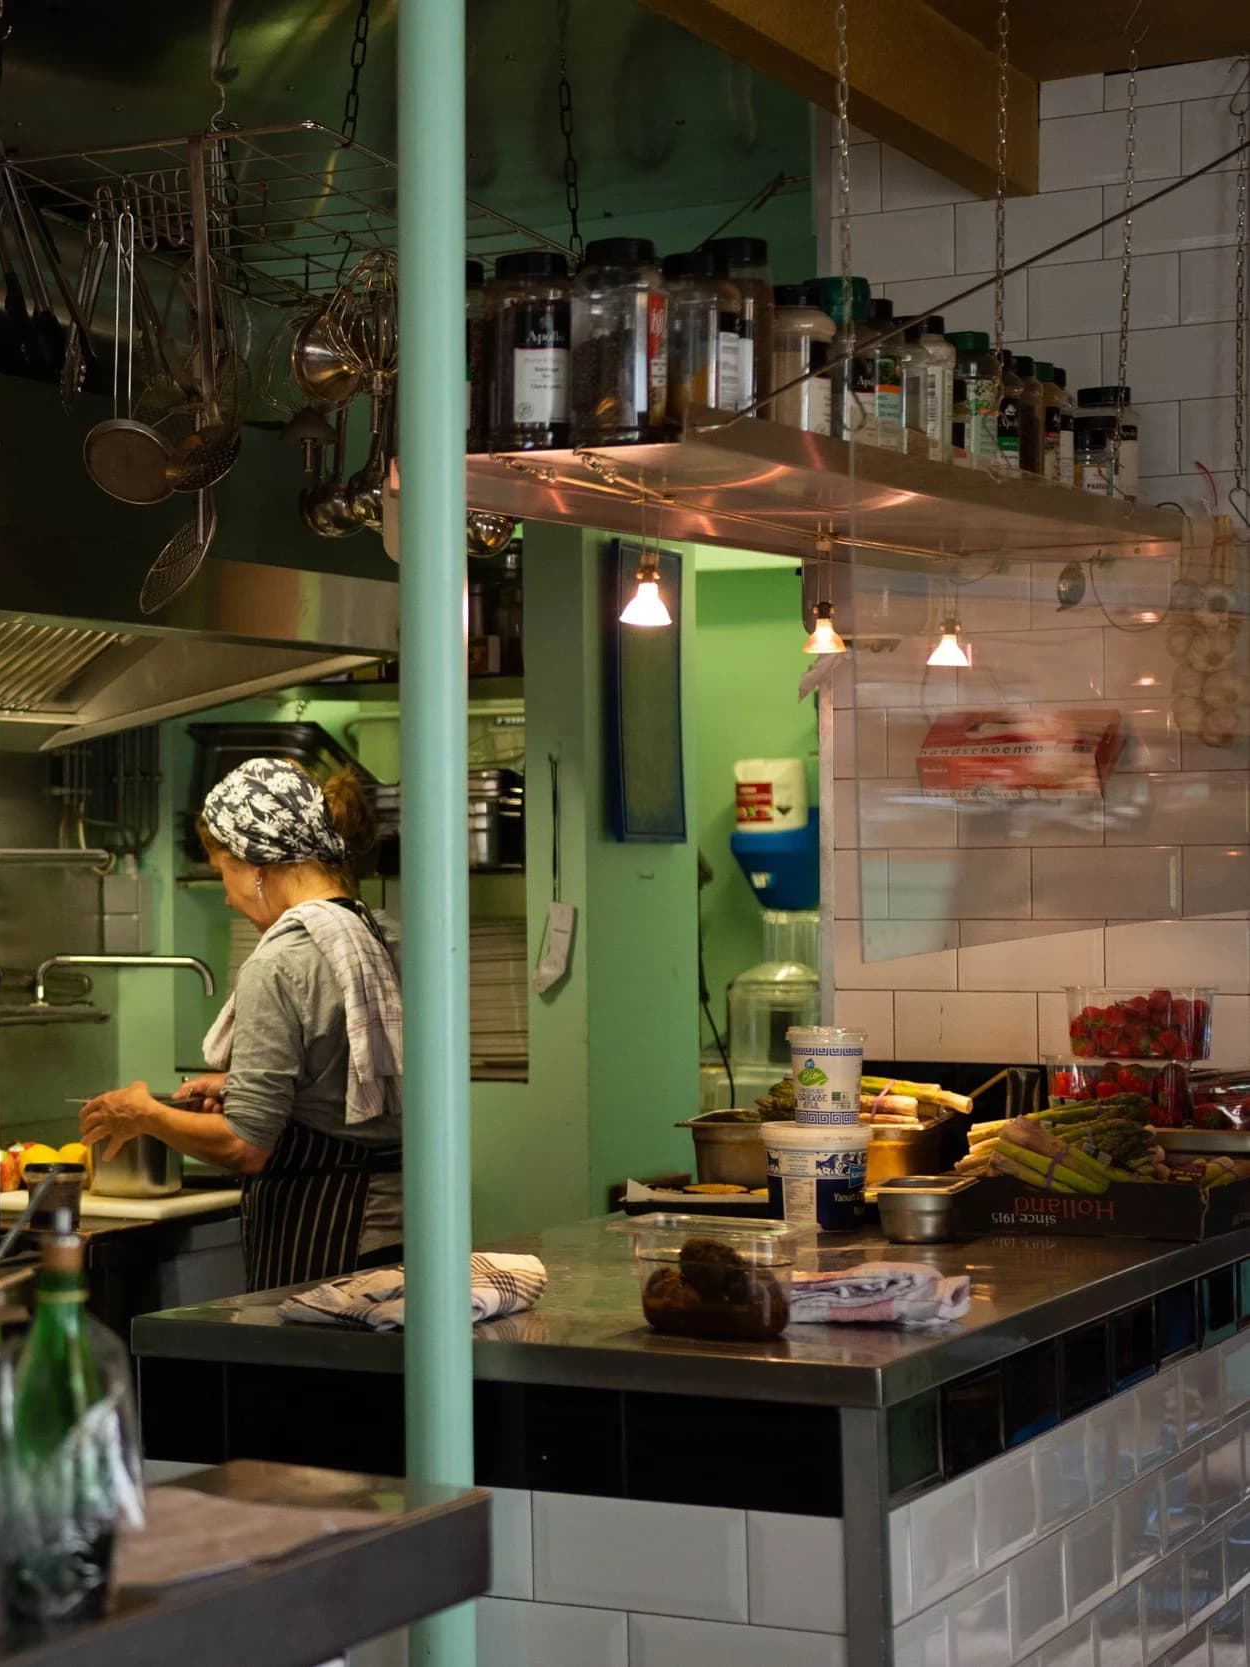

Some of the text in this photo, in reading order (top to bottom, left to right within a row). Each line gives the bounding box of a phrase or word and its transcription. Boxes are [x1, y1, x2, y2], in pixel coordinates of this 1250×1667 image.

[526, 330, 565, 345] Apollo
[1014, 1196, 1115, 1221] Holland
[991, 1211, 1057, 1226] since 1915
